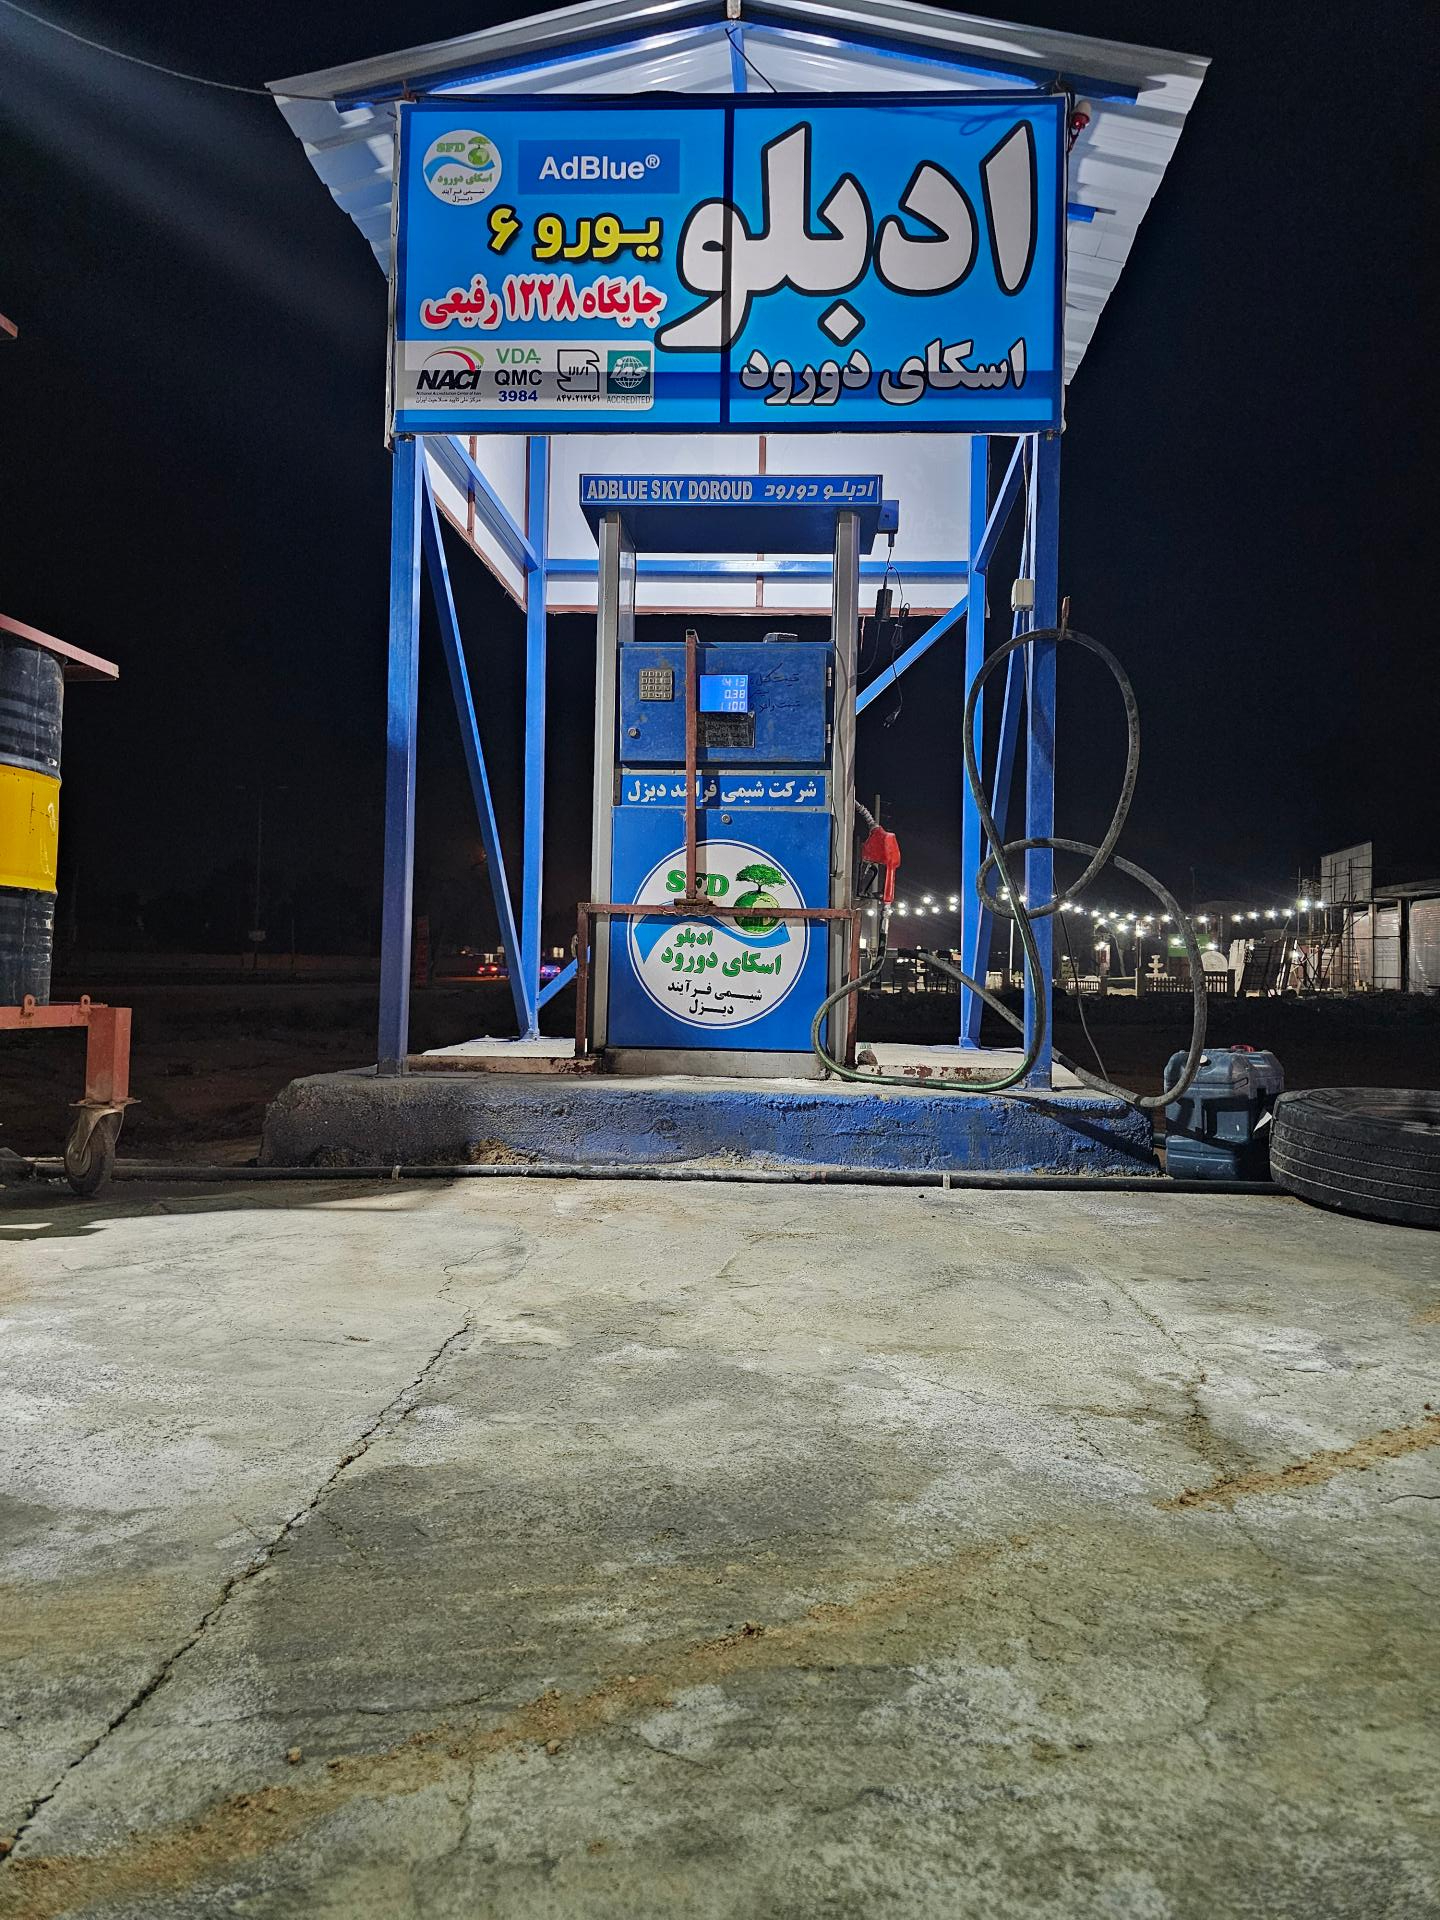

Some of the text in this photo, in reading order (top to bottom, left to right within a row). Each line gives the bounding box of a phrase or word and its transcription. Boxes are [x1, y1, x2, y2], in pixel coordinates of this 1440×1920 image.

[436, 143, 465, 153] SFD
[437, 173, 493, 186] اسکای دورود
[489, 206, 661, 259] یورو ۶
[655, 121, 1038, 353] ادبلو
[423, 278, 663, 325] جایگاه ۱۲۲۸ رفیعی
[496, 348, 541, 364] VDA
[416, 369, 482, 390] NACI
[494, 369, 543, 386] QMC
[738, 337, 1028, 405] اسکای دورود
[498, 390, 538, 402] 3984
[587, 480, 753, 500] ADBLUE SKY DOROUD
[764, 483, 818, 499] دورود
[627, 781, 667, 802] دیزل
[721, 781, 764, 803] شیمی
[768, 781, 817, 802] شرکت
[674, 928, 713, 948] ادبلو
[660, 947, 782, 977] اسکای دورود
[667, 980, 762, 1003] شیمی فرآیند
[689, 999, 734, 1017] دیزل
